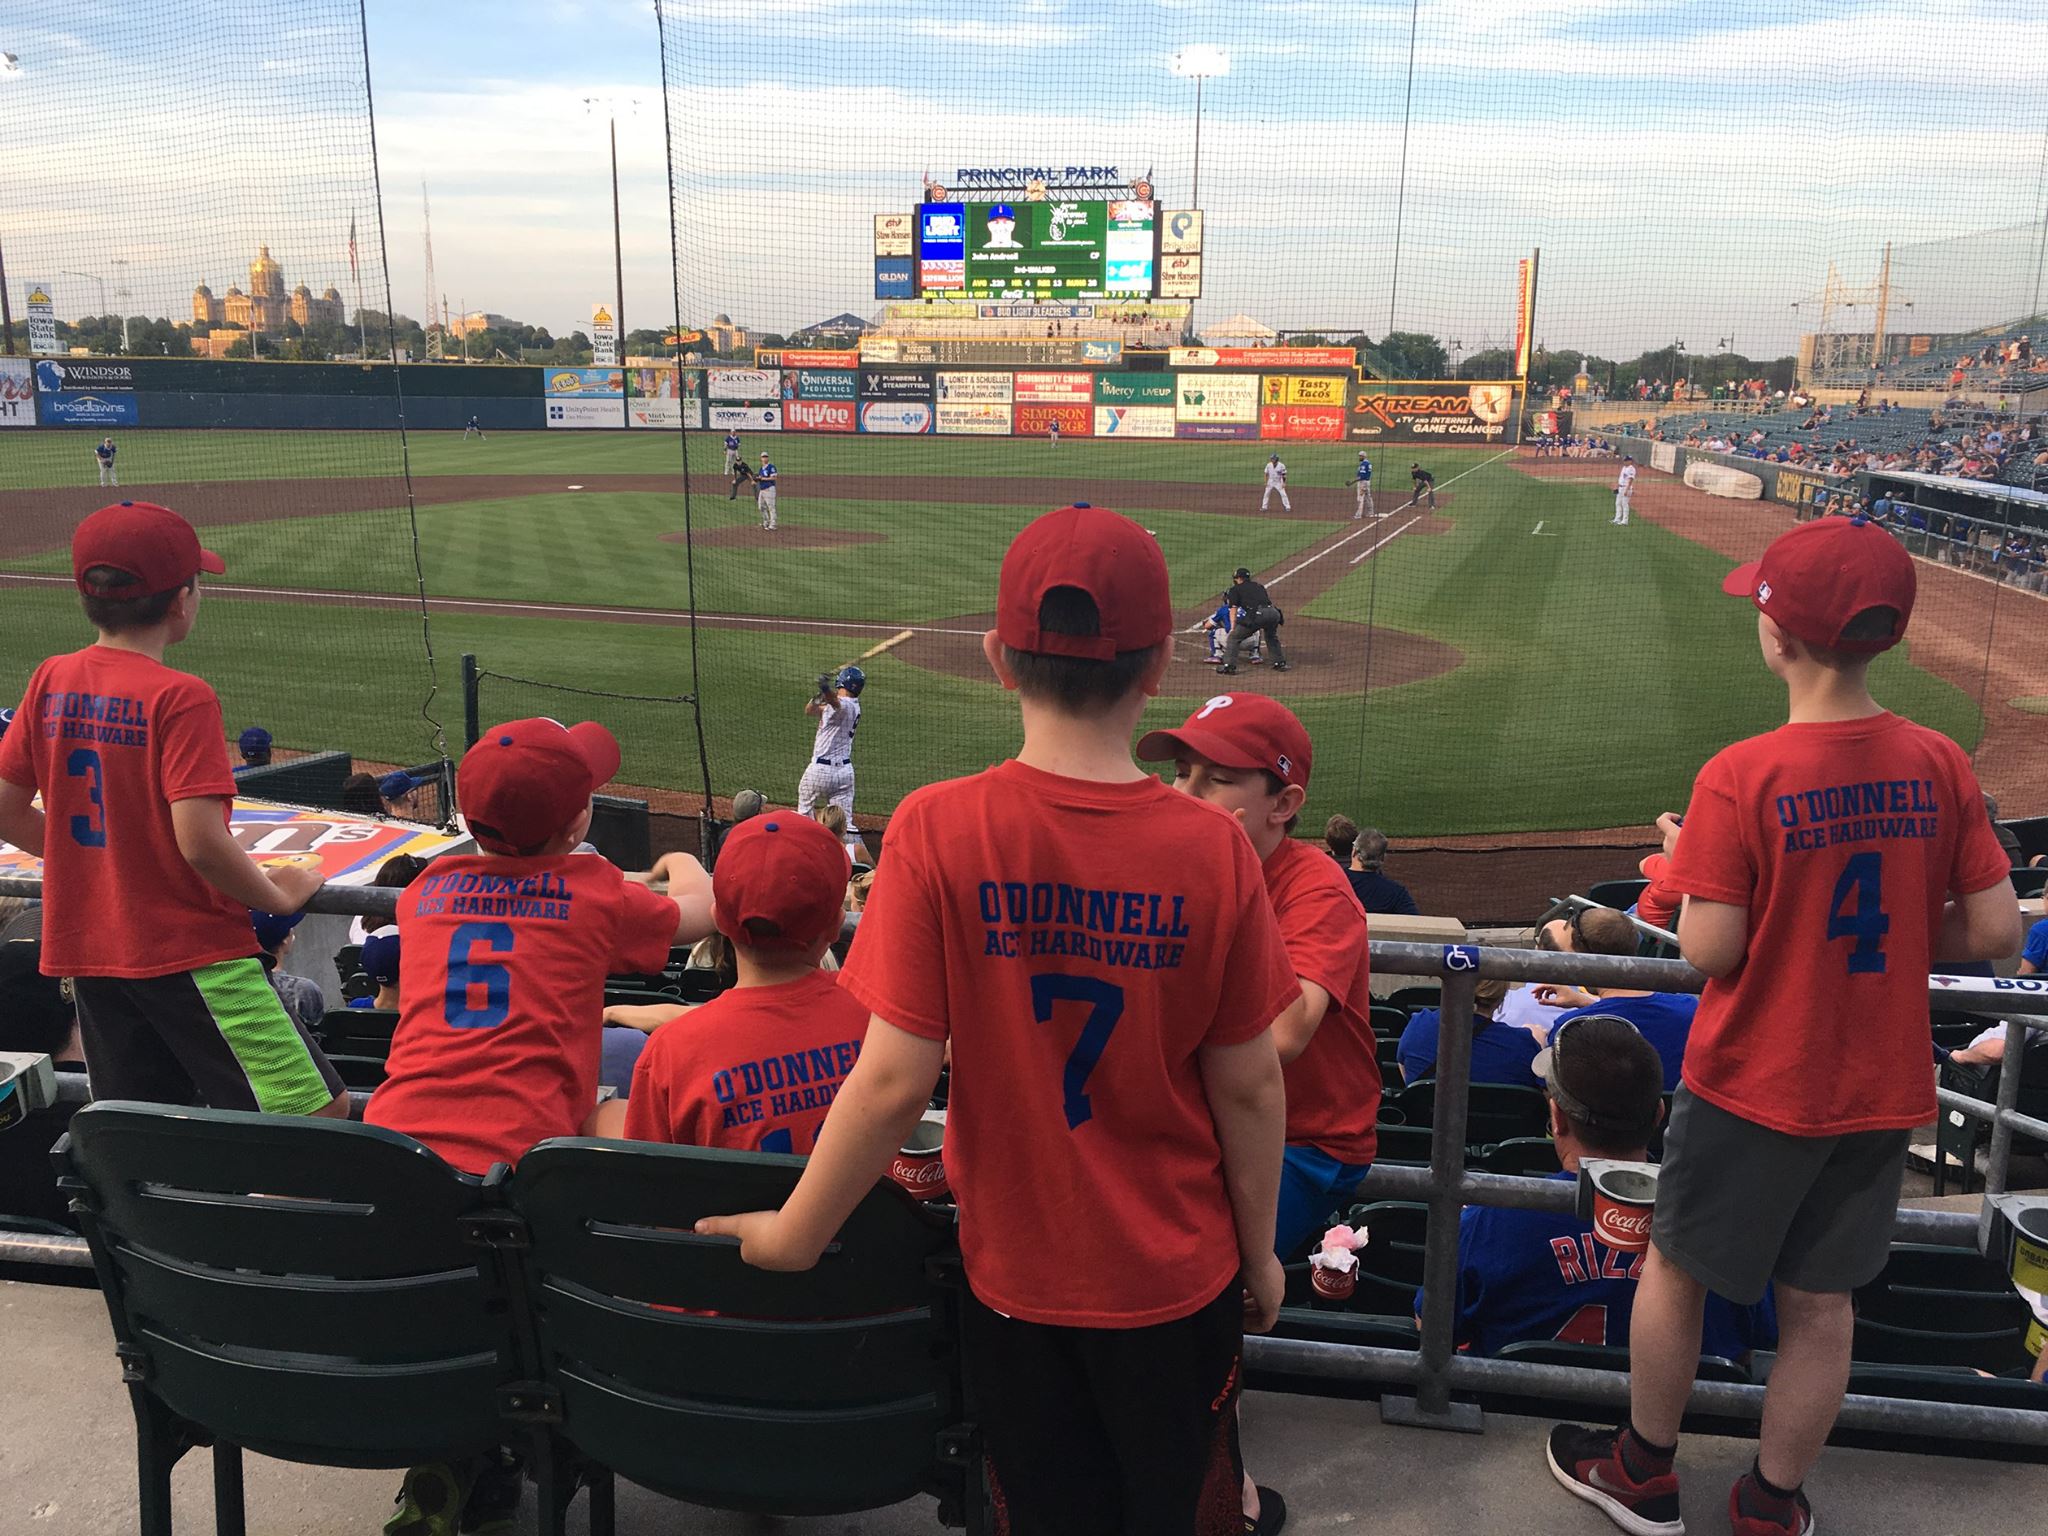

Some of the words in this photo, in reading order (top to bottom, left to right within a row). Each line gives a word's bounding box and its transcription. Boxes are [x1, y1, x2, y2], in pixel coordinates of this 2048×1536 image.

[957, 168, 1058, 181] PRINCIPAL
[1065, 166, 1118, 179] PARK
[877, 231, 889, 239] Stew
[1164, 242, 1198, 251] Principal
[879, 273, 908, 281] GILDAN
[998, 308, 1010, 316] BUD
[1013, 308, 1032, 316] LIGHT
[30, 316, 53, 324] Iowa
[761, 354, 777, 365] CH
[67, 367, 131, 379] WINDSOR
[722, 374, 763, 382] access
[1017, 375, 1062, 383] COMMUNITY
[1063, 374, 1090, 383] CHOICE
[1299, 380, 1331, 390] Tasty
[954, 390, 1003, 398] loneylaw.com
[1107, 386, 1134, 399] Mercy
[1229, 391, 1252, 399] IOWA
[1298, 389, 1330, 398] Tacos
[54, 401, 125, 412] broadlawns
[1022, 409, 1086, 420] SIMPSON
[1021, 421, 1086, 432] COLEGE
[1289, 416, 1314, 425] Great
[1317, 416, 1340, 426] Clips
[1413, 424, 1447, 433] GAME
[1449, 425, 1503, 434] CHANGER
[1197, 695, 1233, 719] P
[67, 748, 106, 848] 3
[1776, 779, 1939, 828] O'DONNELL
[1784, 827, 1827, 854] ACE
[1830, 817, 1937, 845] HARDWARE
[422, 872, 572, 900] O'DONNELL
[416, 897, 446, 917] ACE
[452, 897, 570, 920] HARDWARE
[1827, 852, 1889, 974] 4
[1031, 932, 1185, 969] HARDWARE
[444, 922, 515, 1029] 6
[1993, 979, 2048, 991] BO
[1030, 973, 1124, 1131] 7
[713, 1040, 861, 1103] O'DONNE
[723, 1099, 765, 1128] ACE
